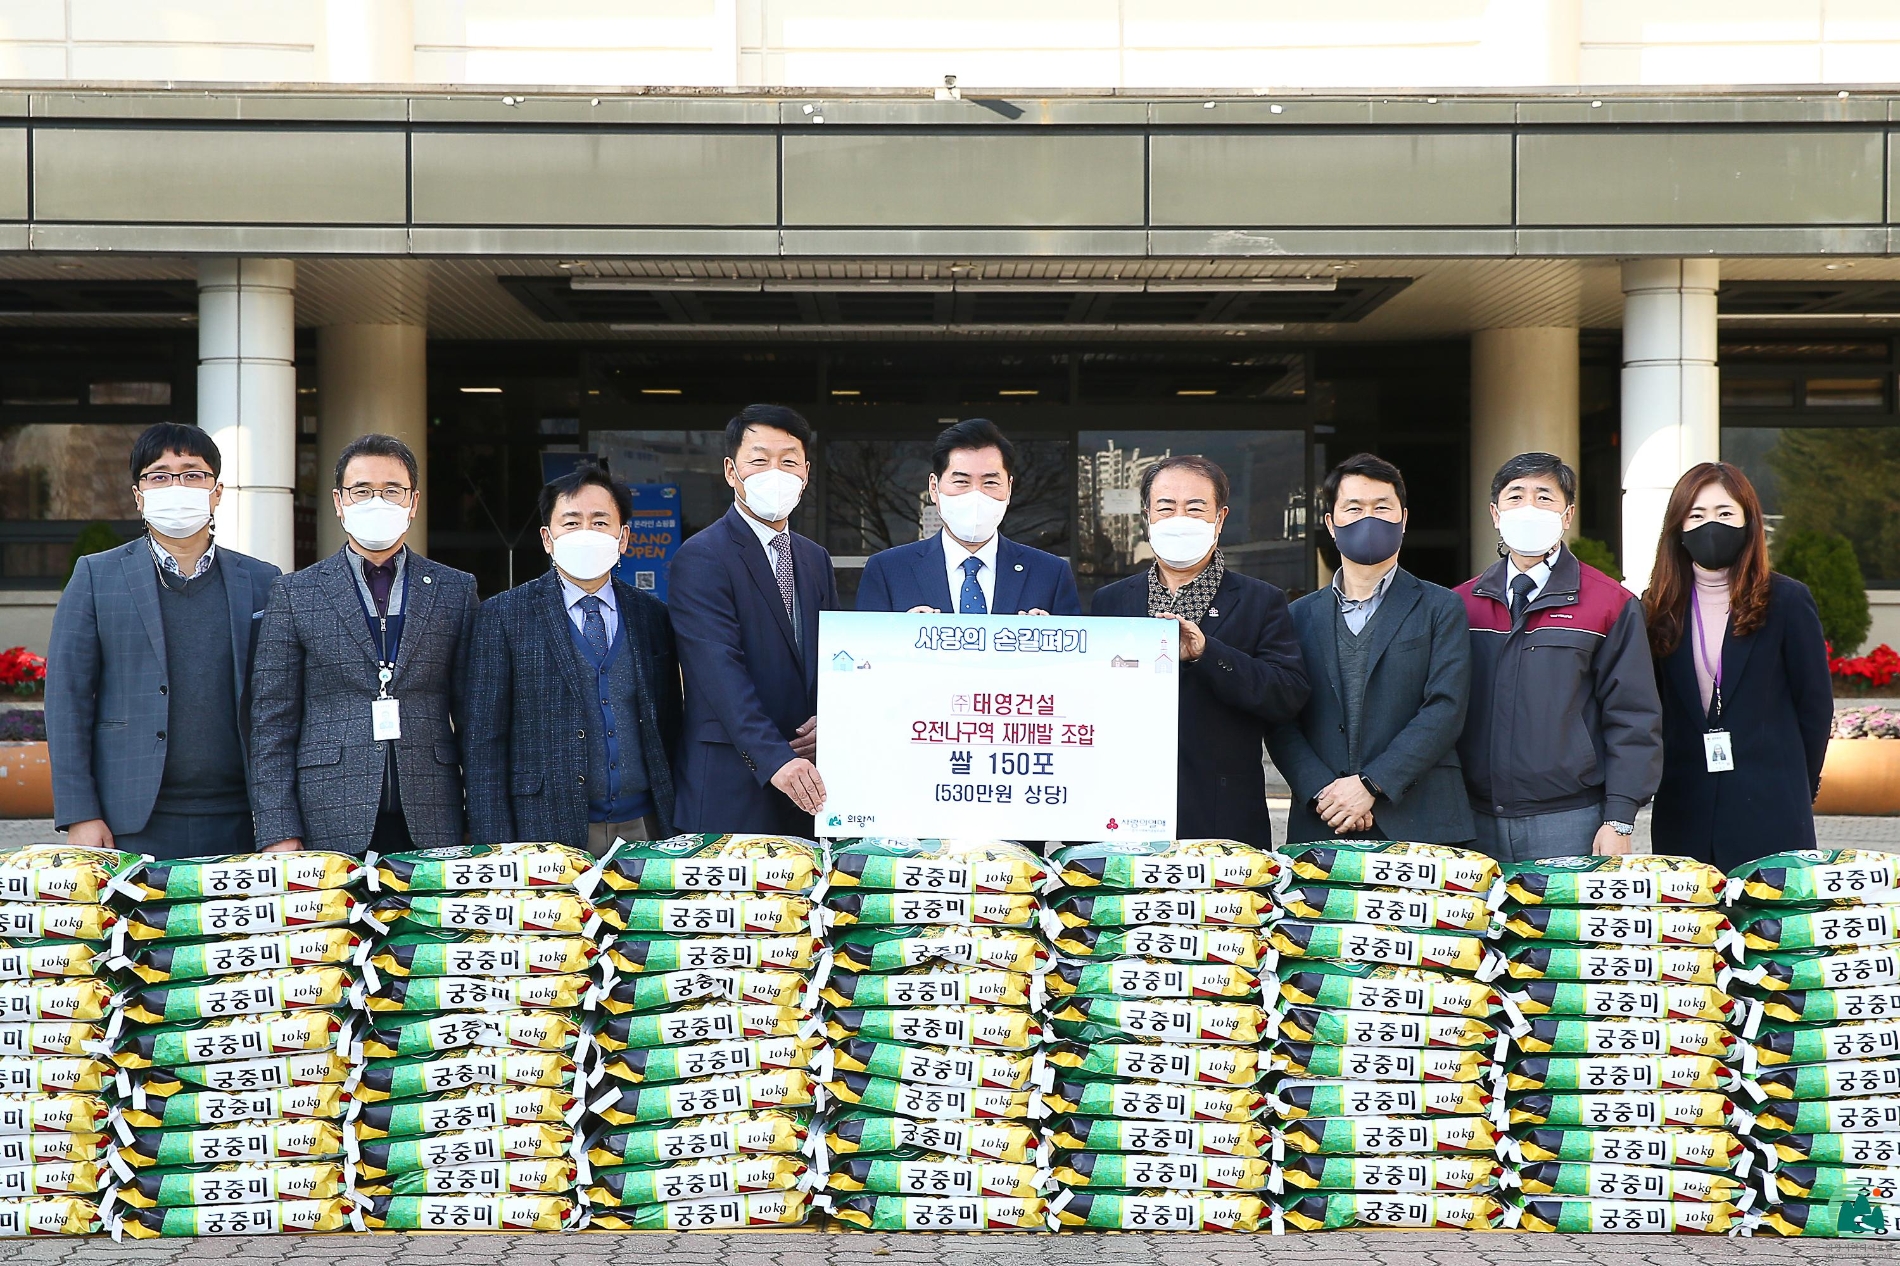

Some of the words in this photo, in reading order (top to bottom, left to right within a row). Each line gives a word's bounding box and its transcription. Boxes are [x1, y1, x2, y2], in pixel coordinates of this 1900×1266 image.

[628, 532, 673, 545] RAND
[624, 545, 667, 559] OPEN
[914, 626, 986, 651] 사랑의
[993, 627, 1087, 653] 손길펴기
[911, 720, 994, 744] 오전나구역
[1002, 722, 1053, 745] 재개발
[1060, 724, 1095, 746] 조합
[949, 750, 973, 775] 쌀
[988, 752, 1054, 776] 150포
[847, 814, 875, 828] 의왕시
[213, 867, 276, 890] 궁중미
[453, 862, 517, 884] 궁중미
[683, 866, 745, 886] 궁중미
[903, 867, 966, 887] 궁중미
[1142, 864, 1204, 884] 궁중미
[1373, 861, 1435, 884] 궁중미
[1824, 868, 1889, 891] 궁중미
[1587, 879, 1650, 899] 궁중미
[209, 903, 274, 928] 궁중미
[449, 905, 513, 925] 궁중미
[671, 908, 733, 928] 궁중미
[901, 900, 963, 919] 궁중미
[1132, 901, 1194, 921] 궁중미
[1365, 899, 1426, 923] 궁중미
[1588, 918, 1651, 938] 궁중미
[1821, 916, 1886, 939] 궁중미
[1135, 932, 1197, 956] 궁중미
[1348, 937, 1412, 960] 궁중미
[213, 944, 279, 969] 궁중미
[454, 950, 518, 970] 궁중미
[688, 946, 750, 970] 궁중미
[1589, 957, 1652, 977] 궁중미
[1832, 957, 1893, 982] 궁중미
[896, 981, 958, 1001] 궁중미
[1121, 971, 1182, 991] 궁중미
[207, 987, 274, 1012] 궁중미
[1359, 987, 1423, 1009] 궁중미
[1595, 992, 1657, 1013] 궁중미
[668, 1015, 737, 1041] 궁중미
[901, 1019, 963, 1040] 궁중미
[1127, 1010, 1190, 1032] 궁중미
[195, 1032, 262, 1057] 궁중미
[1355, 1023, 1419, 1046] 궁중미
[1596, 1029, 1659, 1049] 궁중미
[690, 1048, 749, 1072] 궁중미
[911, 1056, 972, 1081] 궁중미
[1126, 1052, 1189, 1075] 궁중미
[1350, 1054, 1413, 1078] 궁중미
[214, 1066, 282, 1091] 궁중미
[1588, 1065, 1651, 1085] 궁중미
[207, 1098, 271, 1118] 궁중미
[678, 1086, 741, 1111] 궁중미
[906, 1089, 964, 1112] 궁중미
[1122, 1092, 1184, 1115] 궁중미
[1352, 1091, 1415, 1111] 궁중미
[431, 1103, 495, 1130] 궁중미
[1591, 1102, 1654, 1122] 궁중미
[201, 1135, 267, 1158] 궁중미
[665, 1132, 728, 1156] 궁중미
[1129, 1129, 1192, 1149] 궁중미
[1364, 1127, 1427, 1147] 궁중미
[428, 1139, 493, 1166] 궁중미
[1602, 1139, 1665, 1160] 궁중미
[434, 1169, 498, 1189] 궁중미
[908, 1169, 971, 1191] 궁중미
[1134, 1163, 1196, 1182] 궁중미
[1363, 1165, 1426, 1186] 궁중미
[1600, 1173, 1662, 1194] 궁중미
[201, 1178, 267, 1200] 궁중미
[664, 1172, 728, 1198] 궁중미
[205, 1210, 272, 1232] 궁중미
[428, 1205, 491, 1225] 궁중미
[675, 1202, 738, 1226] 궁중미
[914, 1204, 977, 1225] 궁중미
[1131, 1205, 1193, 1225] 궁중미
[1364, 1202, 1426, 1223] 궁중미
[1600, 1209, 1665, 1229] 궁중미
